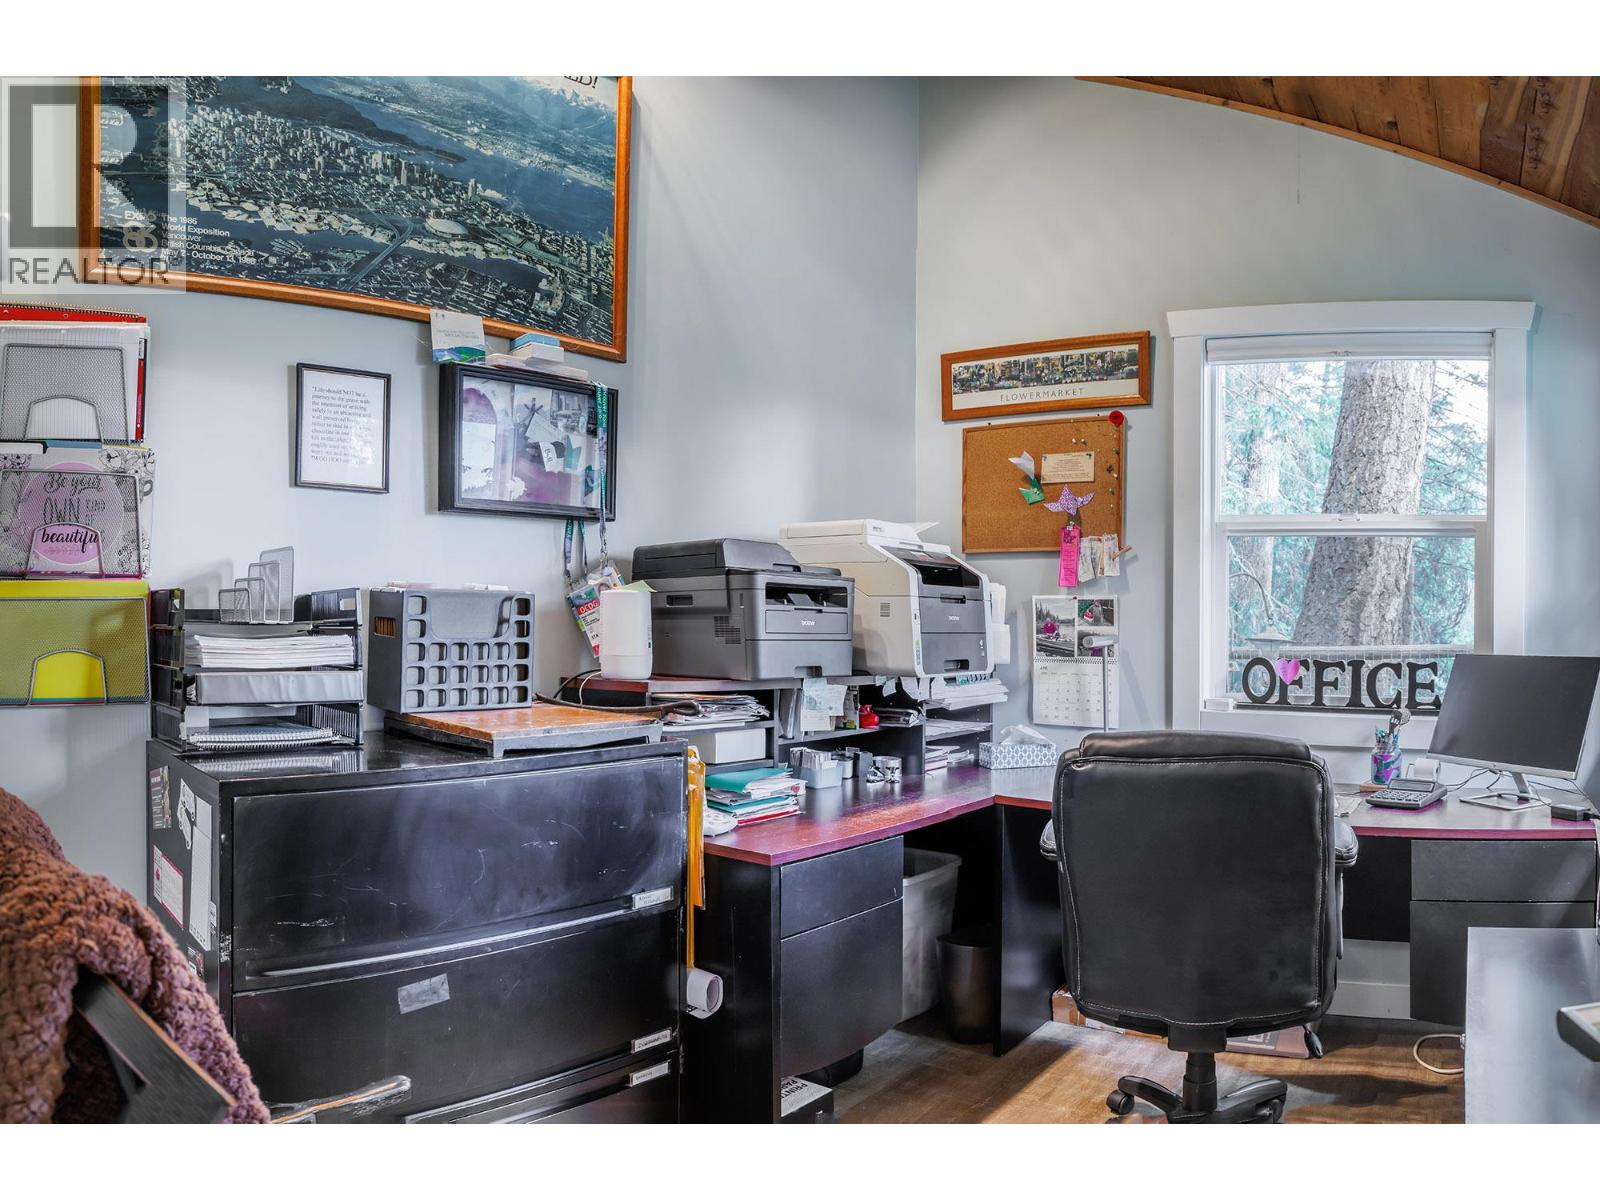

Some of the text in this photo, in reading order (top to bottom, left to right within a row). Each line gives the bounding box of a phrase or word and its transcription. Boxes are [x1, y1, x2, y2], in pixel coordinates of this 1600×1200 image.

[161, 213, 198, 225] The 1986
[161, 222, 231, 238] World Exposition
[161, 230, 202, 242] Vancouver
[161, 238, 185, 249] British
[191, 250, 225, 261] October
[1000, 388, 1085, 402] FLOWERMARKET
[41, 528, 99, 554] beautifu
[1242, 656, 1442, 710] OFFICE
